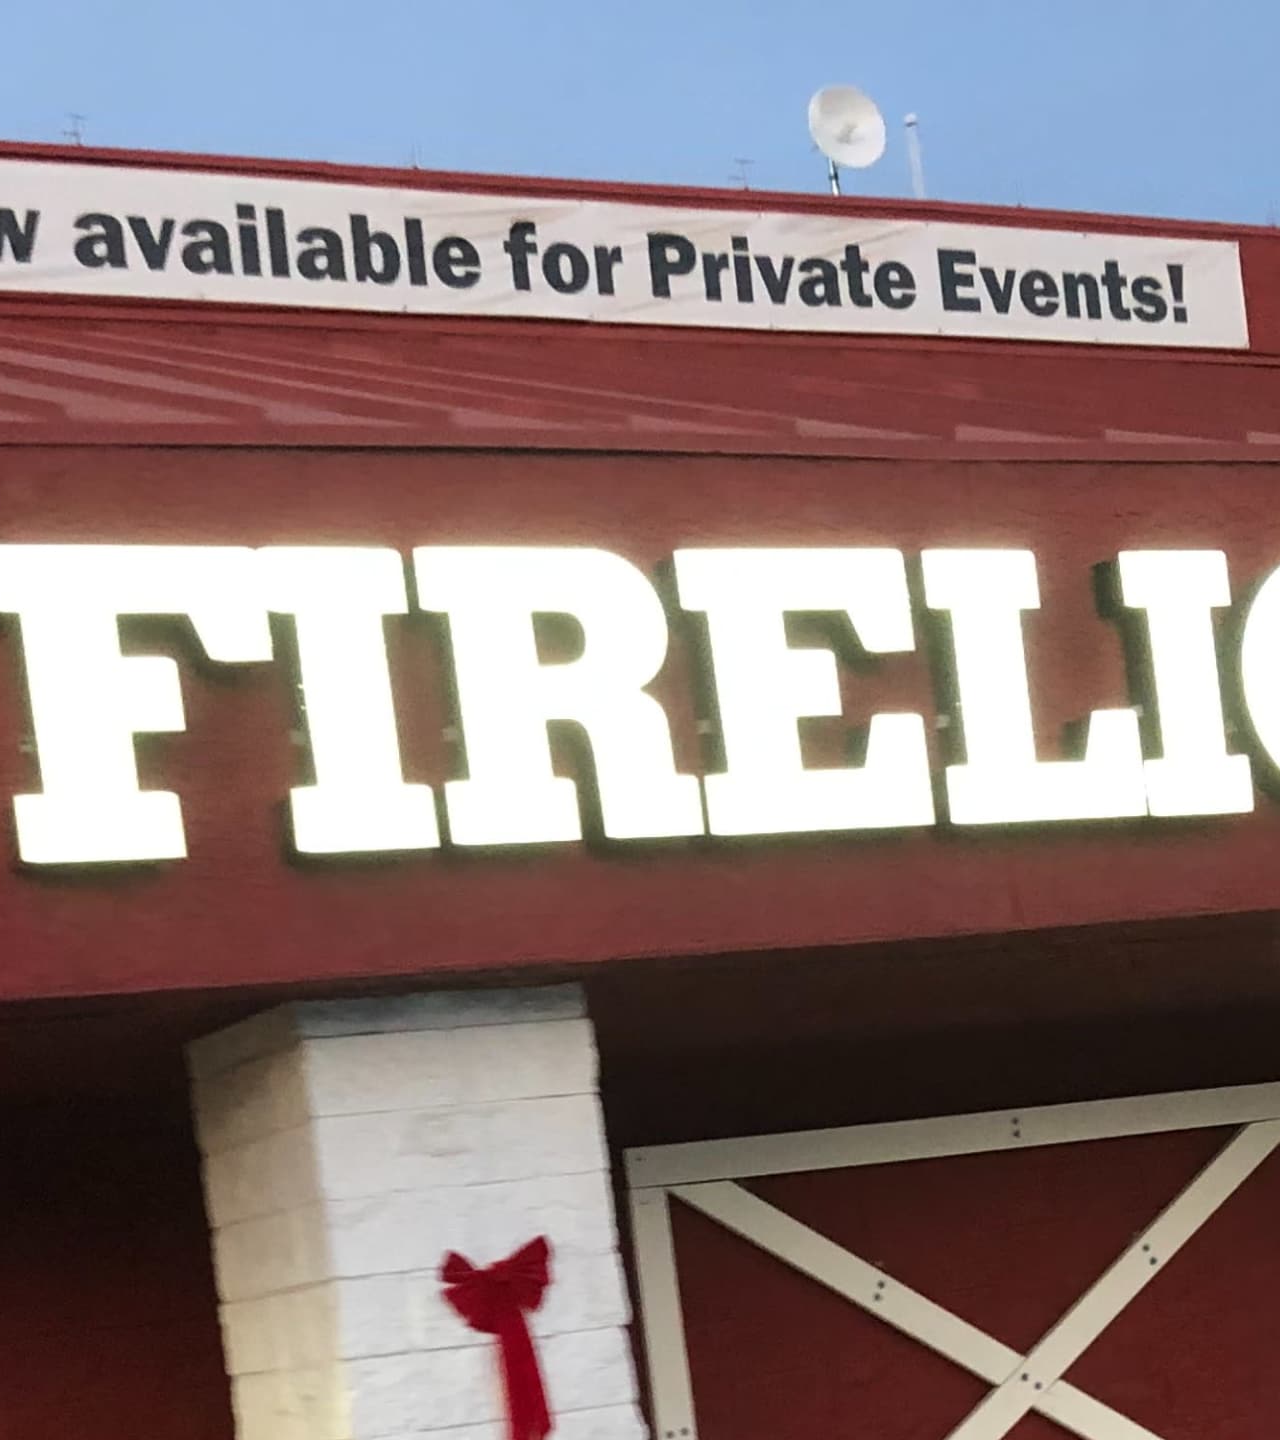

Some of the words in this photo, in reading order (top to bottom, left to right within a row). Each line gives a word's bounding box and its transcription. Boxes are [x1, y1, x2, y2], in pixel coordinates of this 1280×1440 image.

[72, 203, 482, 290] available
[503, 218, 624, 297] for
[646, 230, 918, 312] Private
[936, 247, 1190, 325] Events!
